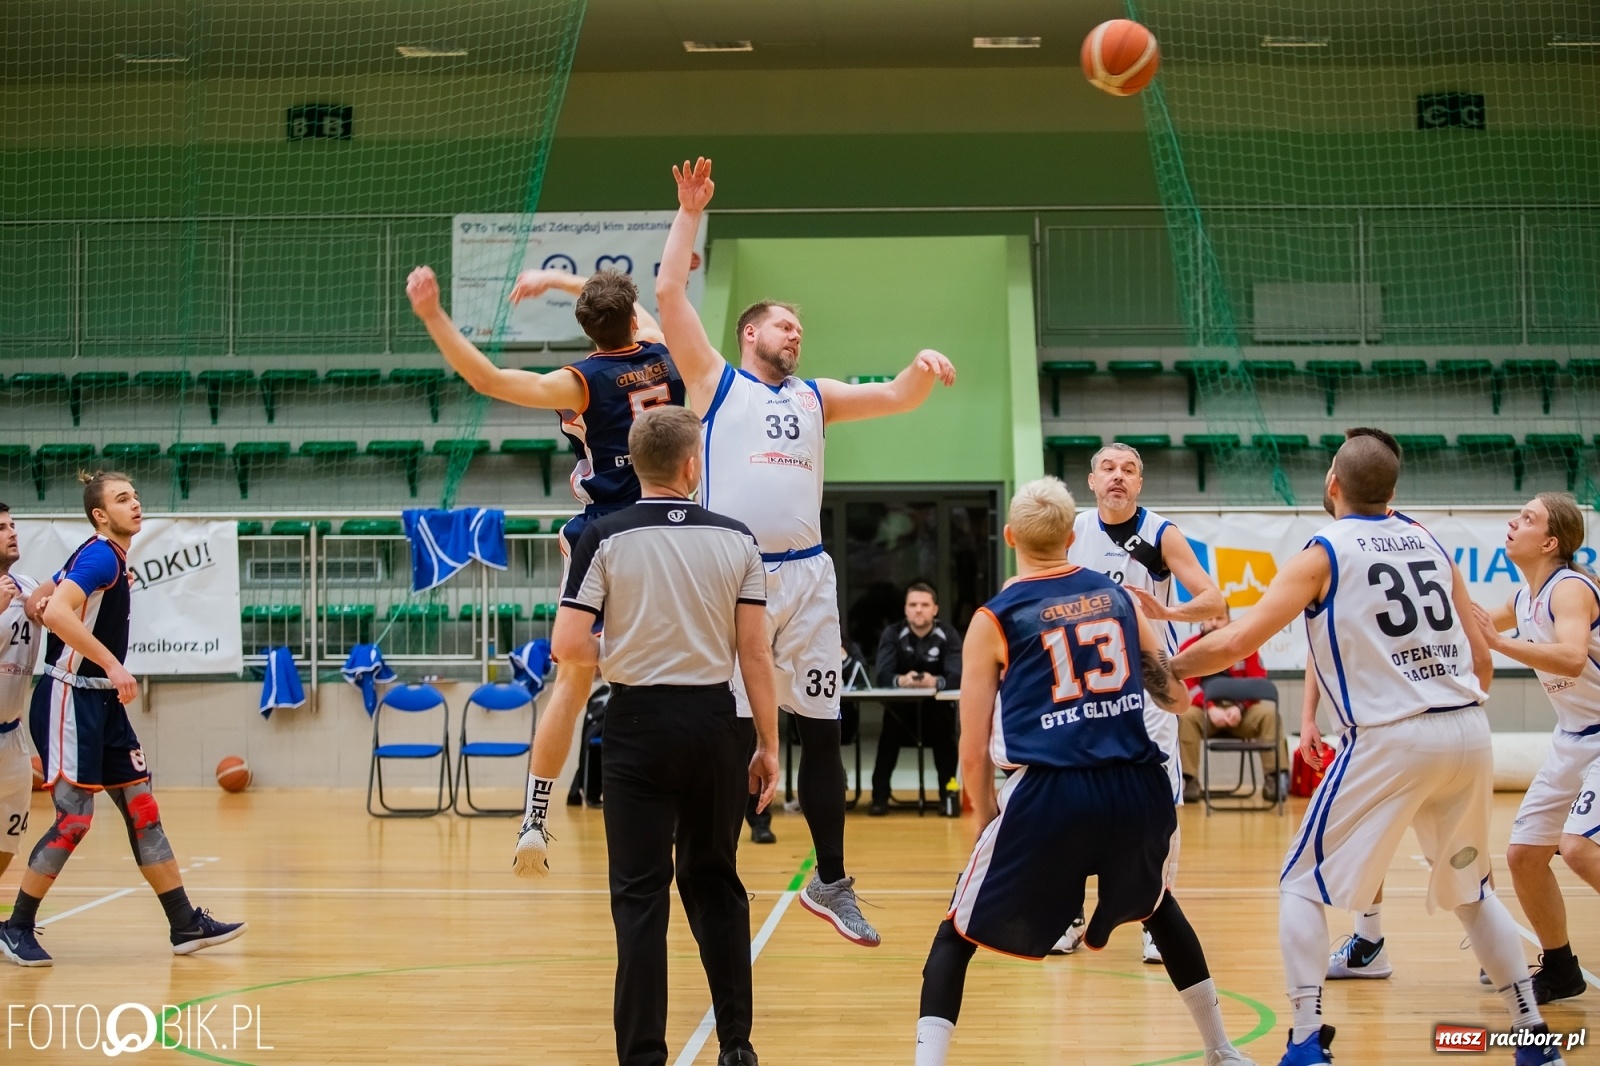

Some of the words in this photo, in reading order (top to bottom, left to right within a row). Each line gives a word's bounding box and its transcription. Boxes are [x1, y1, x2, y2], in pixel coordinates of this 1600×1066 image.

[548, 221, 600, 235] Zdecyduj
[603, 222, 624, 231] kim
[765, 414, 800, 440] 33
[615, 454, 633, 468] GT
[1123, 535, 1142, 551] C
[1357, 538, 1371, 552] P.
[1373, 535, 1426, 553] SZKLARZ
[1367, 560, 1454, 638] 35
[10, 620, 31, 646] 24
[1040, 617, 1131, 704] 13
[805, 669, 837, 698] 33
[1040, 706, 1080, 730] GTK
[1570, 790, 1596, 815] 3
[7, 812, 29, 836] 24
